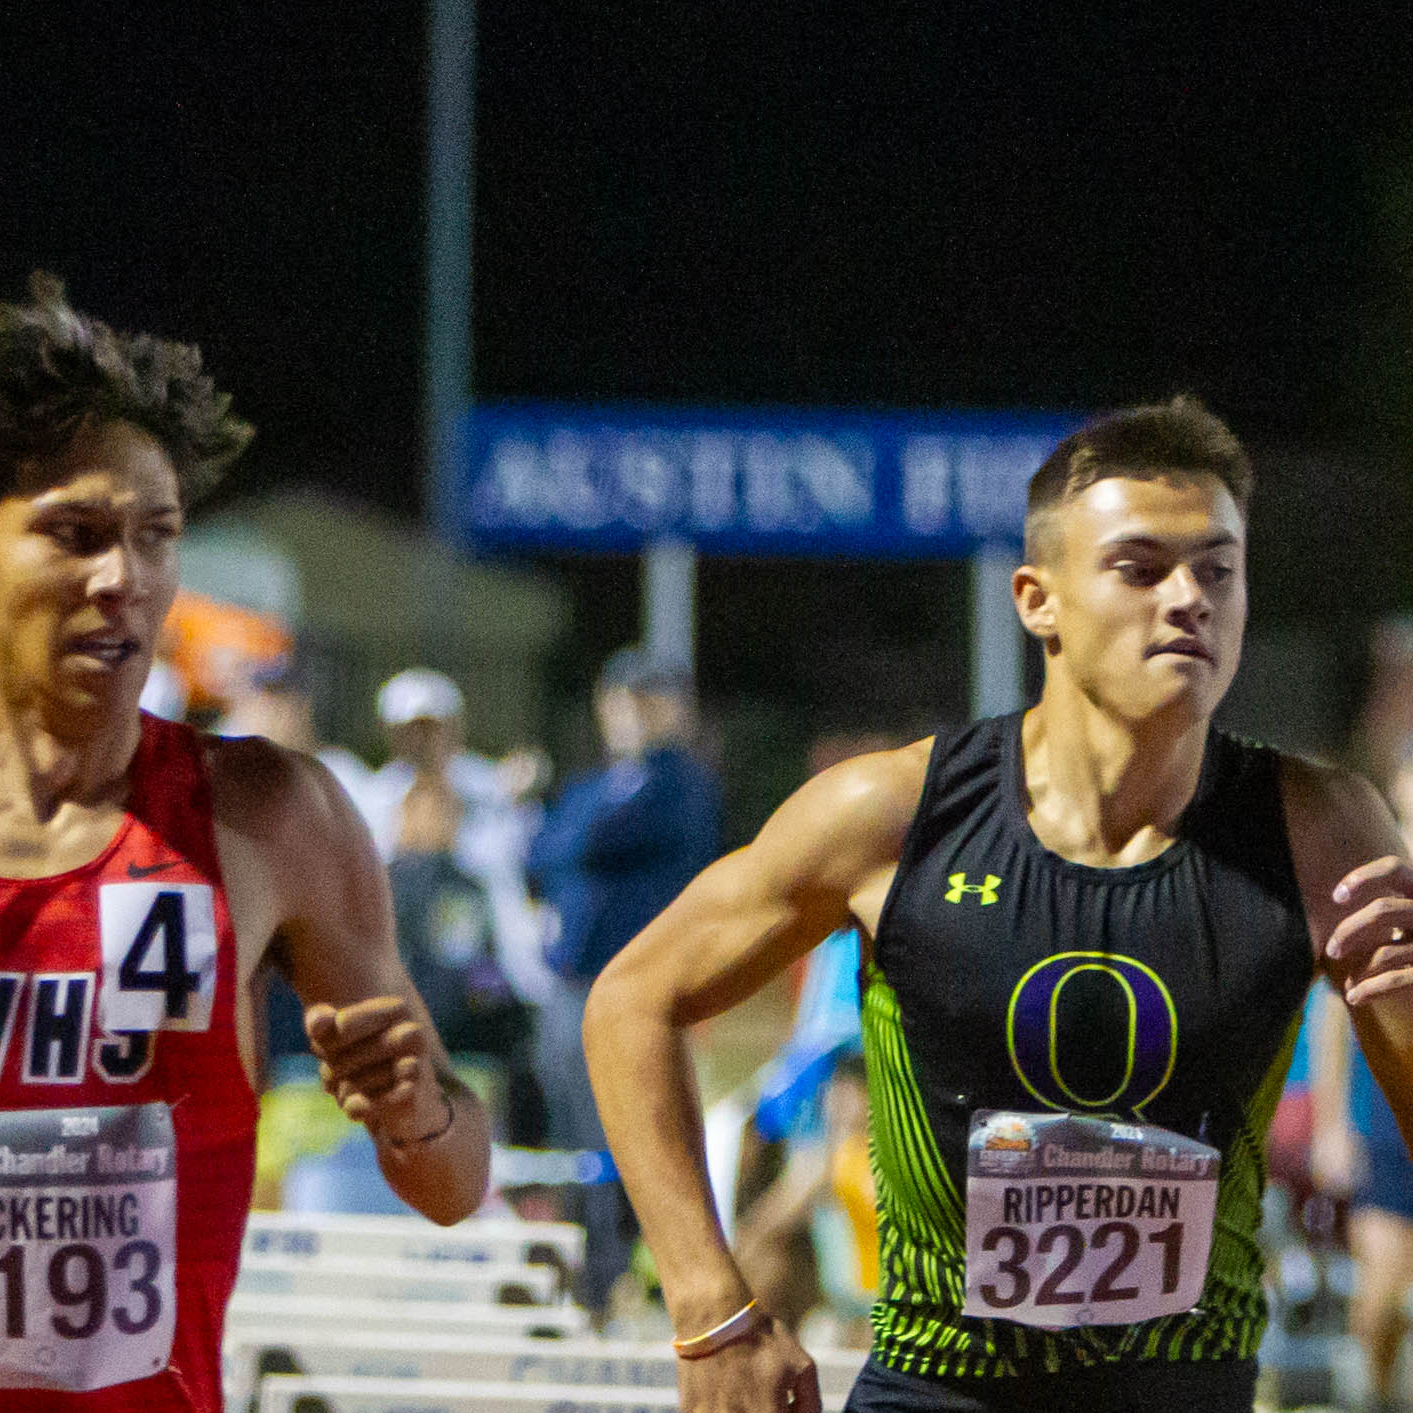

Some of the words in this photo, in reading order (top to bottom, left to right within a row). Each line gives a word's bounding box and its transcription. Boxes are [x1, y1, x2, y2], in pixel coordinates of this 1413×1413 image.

[119, 891, 201, 1018] 4
[96, 1143, 170, 1176] Rotary
[1044, 1142, 1135, 1168] Chandler
[1141, 1146, 1211, 1177] Rotary
[1004, 1184, 1180, 1223] RIPPERDAN
[979, 1221, 1185, 1309] 3221
